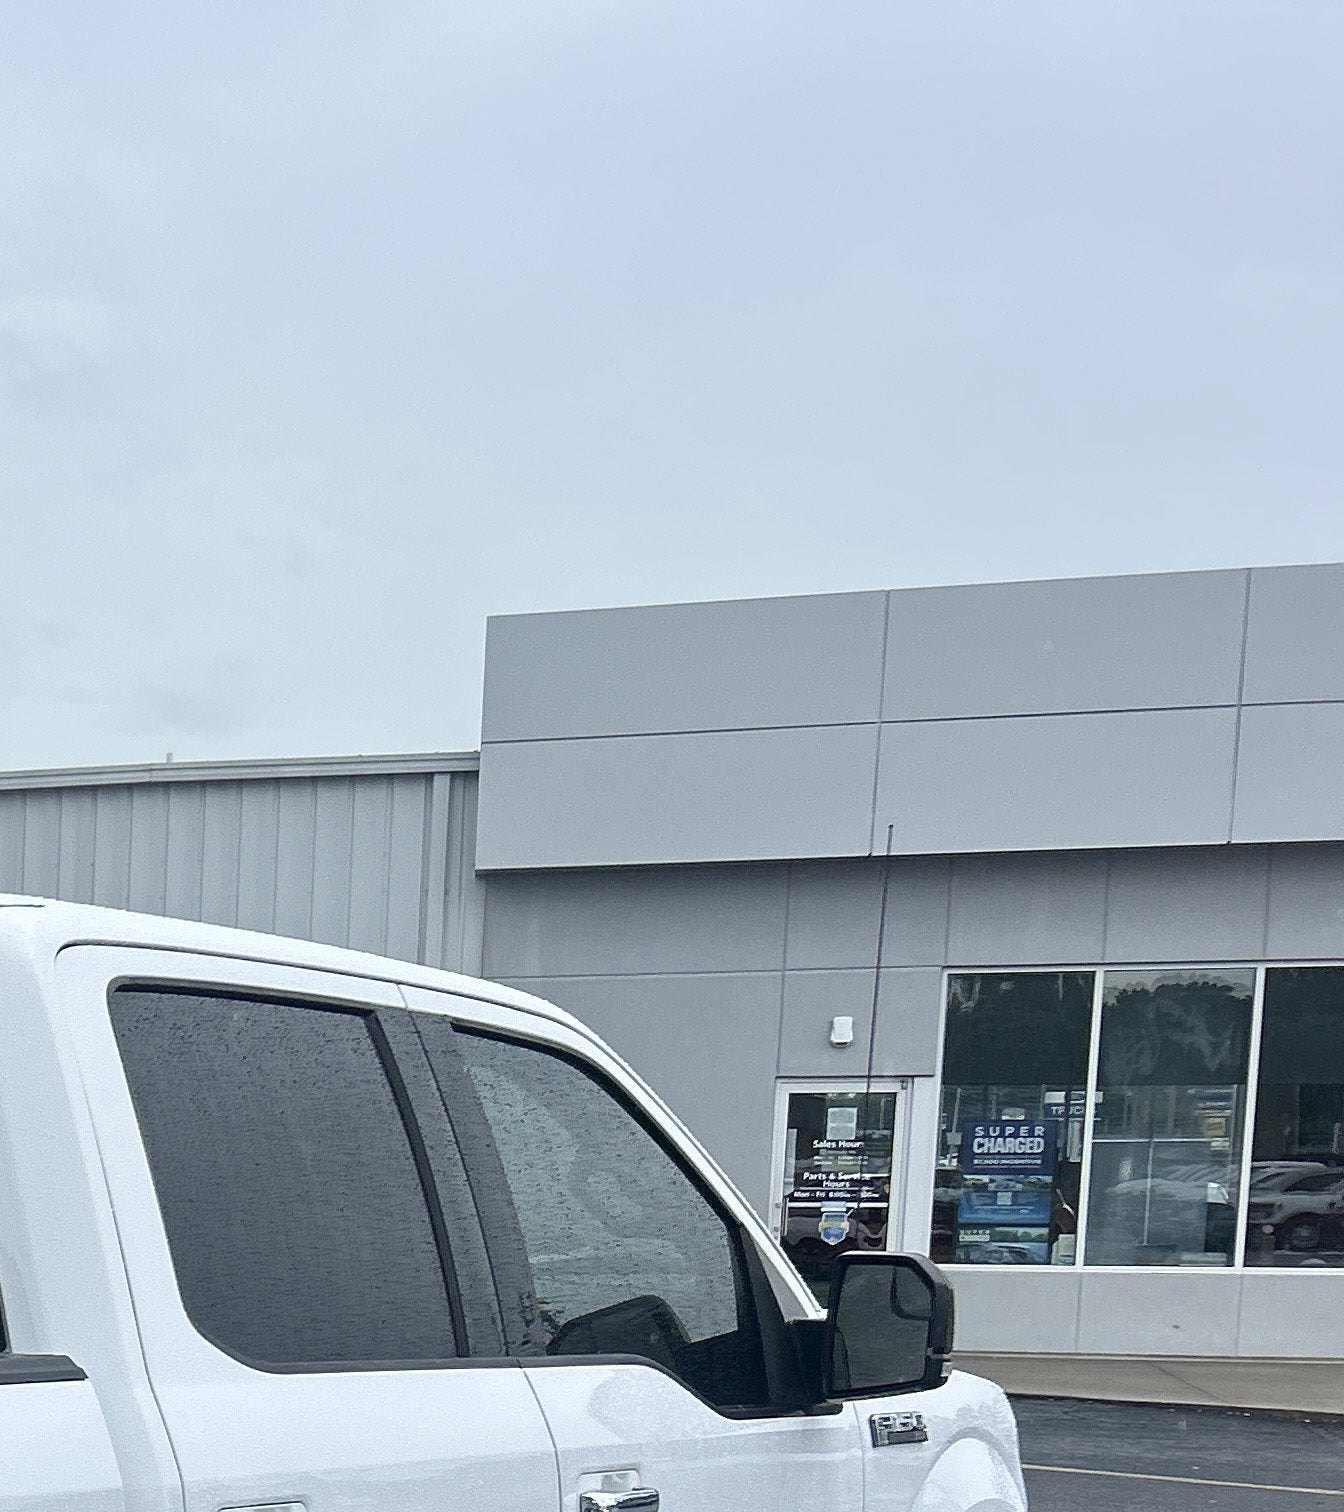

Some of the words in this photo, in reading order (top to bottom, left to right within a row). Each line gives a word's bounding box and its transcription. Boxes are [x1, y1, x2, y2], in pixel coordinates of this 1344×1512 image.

[975, 1126, 1045, 1137] SUPER
[813, 1140, 837, 1149] Sales
[838, 1140, 864, 1149] Hours
[972, 1137, 1045, 1154] CHARGED
[803, 1172, 827, 1180] Parts
[823, 1180, 850, 1188] Hours
